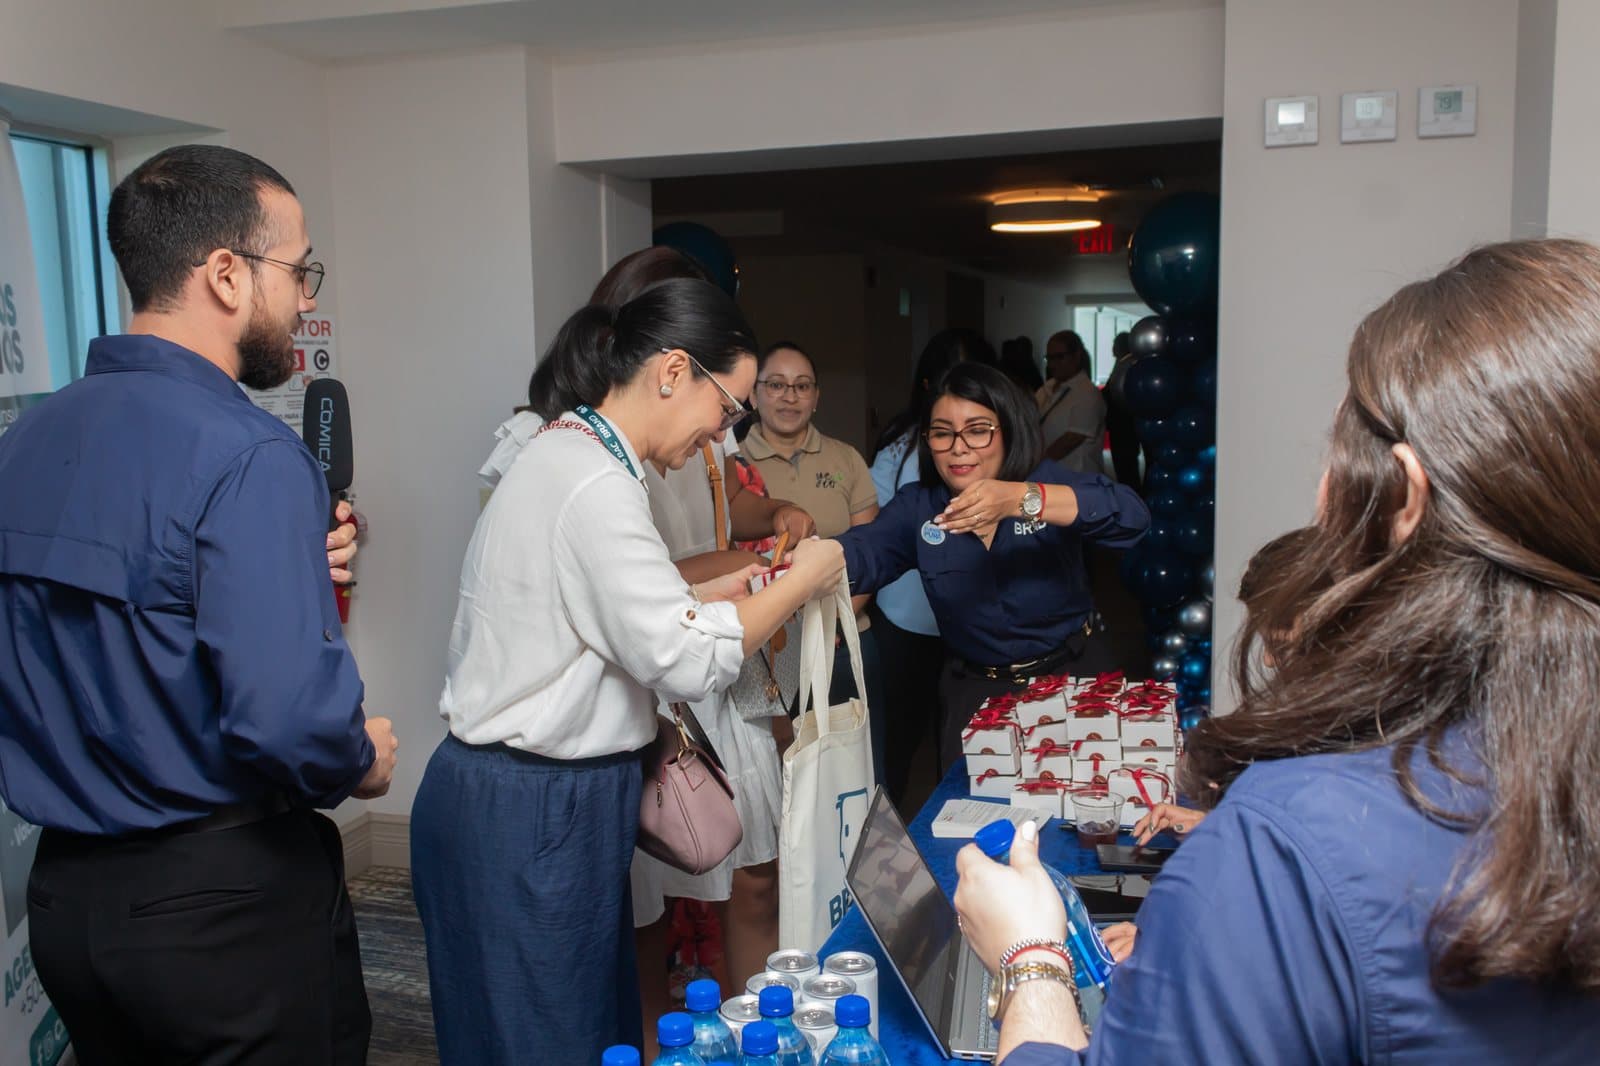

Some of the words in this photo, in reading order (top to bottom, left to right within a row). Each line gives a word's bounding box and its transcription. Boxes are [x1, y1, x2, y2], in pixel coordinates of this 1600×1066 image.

[296, 320, 332, 336] TOR
[319, 397, 334, 472] COMICA
[5, 943, 33, 1008] AGE
